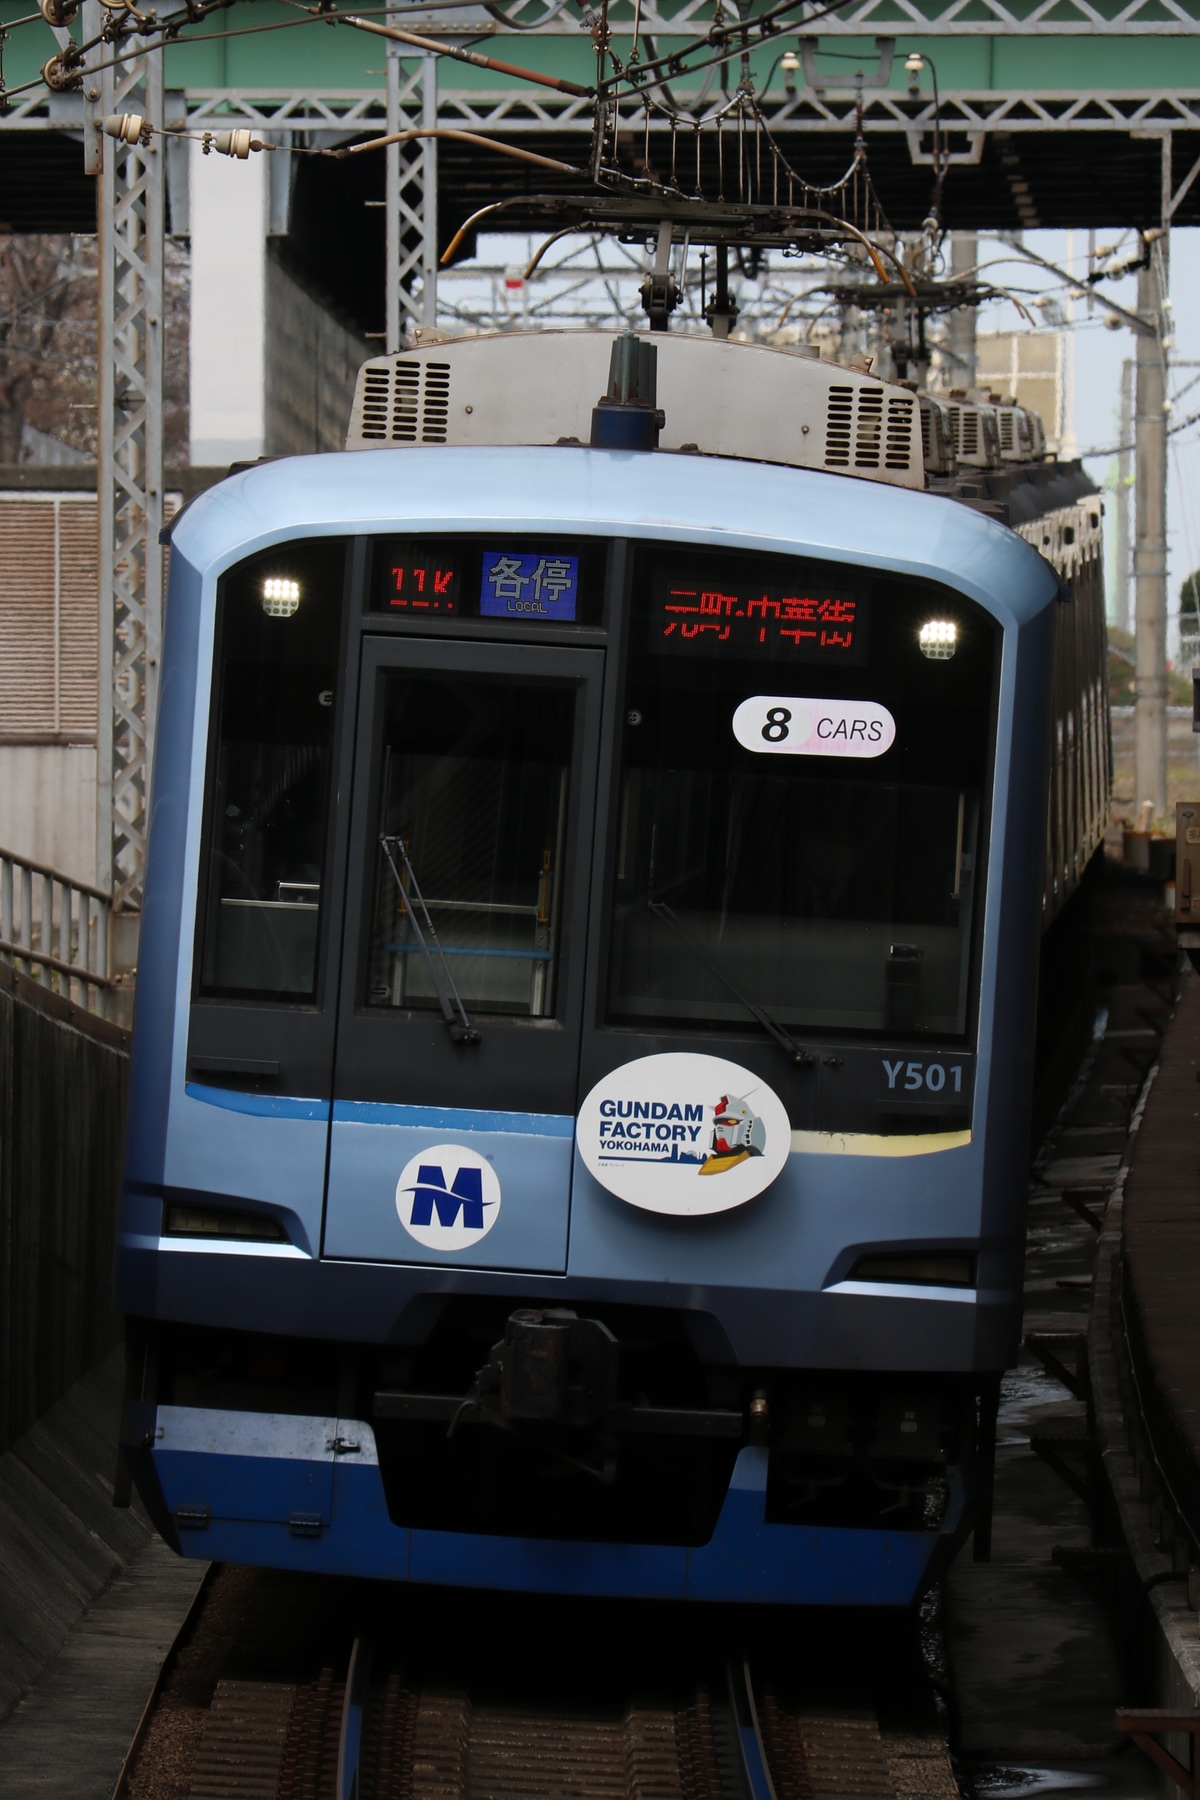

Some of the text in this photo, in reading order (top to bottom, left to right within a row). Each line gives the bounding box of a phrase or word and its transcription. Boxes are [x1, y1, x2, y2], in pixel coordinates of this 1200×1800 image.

[391, 567, 453, 609] 11K
[488, 556, 572, 601] 各停
[507, 601, 548, 613] LOCAL
[761, 707, 884, 742] 8 CARS
[881, 1060, 962, 1092] Y501
[599, 1099, 703, 1122] GUNDAM
[599, 1120, 702, 1141] FACTORY
[599, 1140, 669, 1153] YOKOHAMA
[401, 1164, 496, 1229] M
